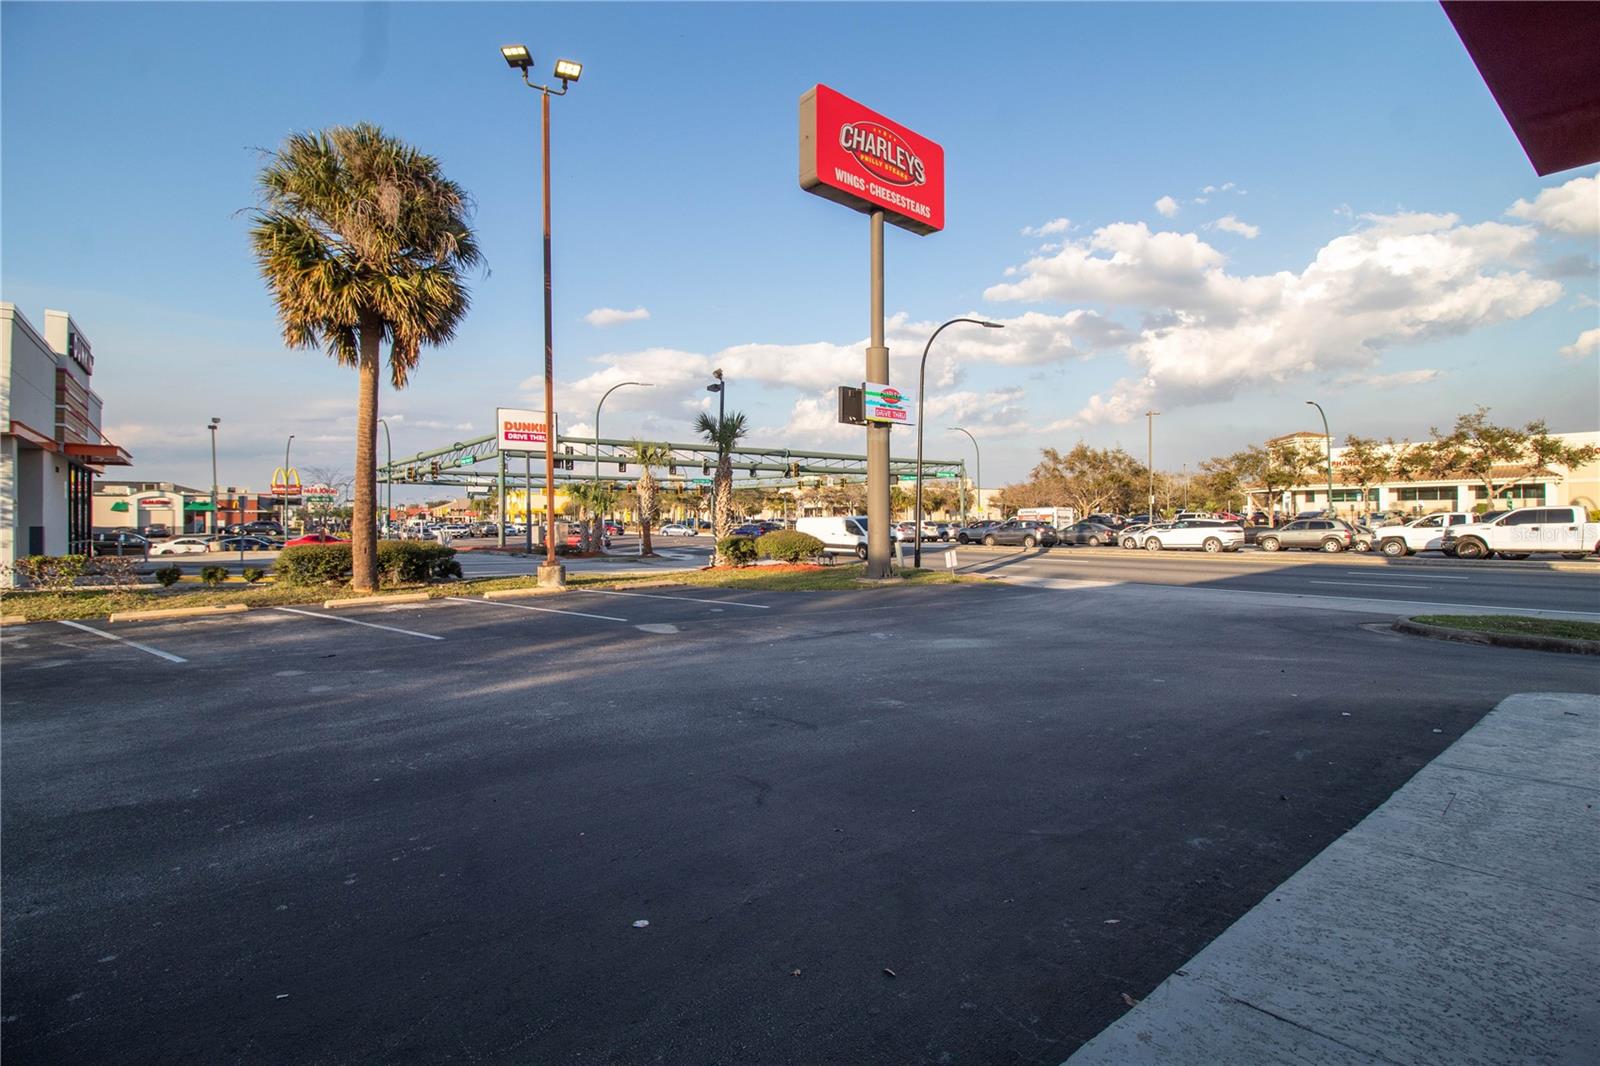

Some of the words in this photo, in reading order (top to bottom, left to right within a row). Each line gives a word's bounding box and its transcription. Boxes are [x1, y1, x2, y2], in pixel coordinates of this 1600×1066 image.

[840, 125, 925, 183] CHARLEYS
[859, 153, 883, 167] PHILLY
[884, 163, 908, 180] STEAKS
[835, 167, 865, 191] WINGS
[869, 182, 931, 218] CHEESESTEAKS
